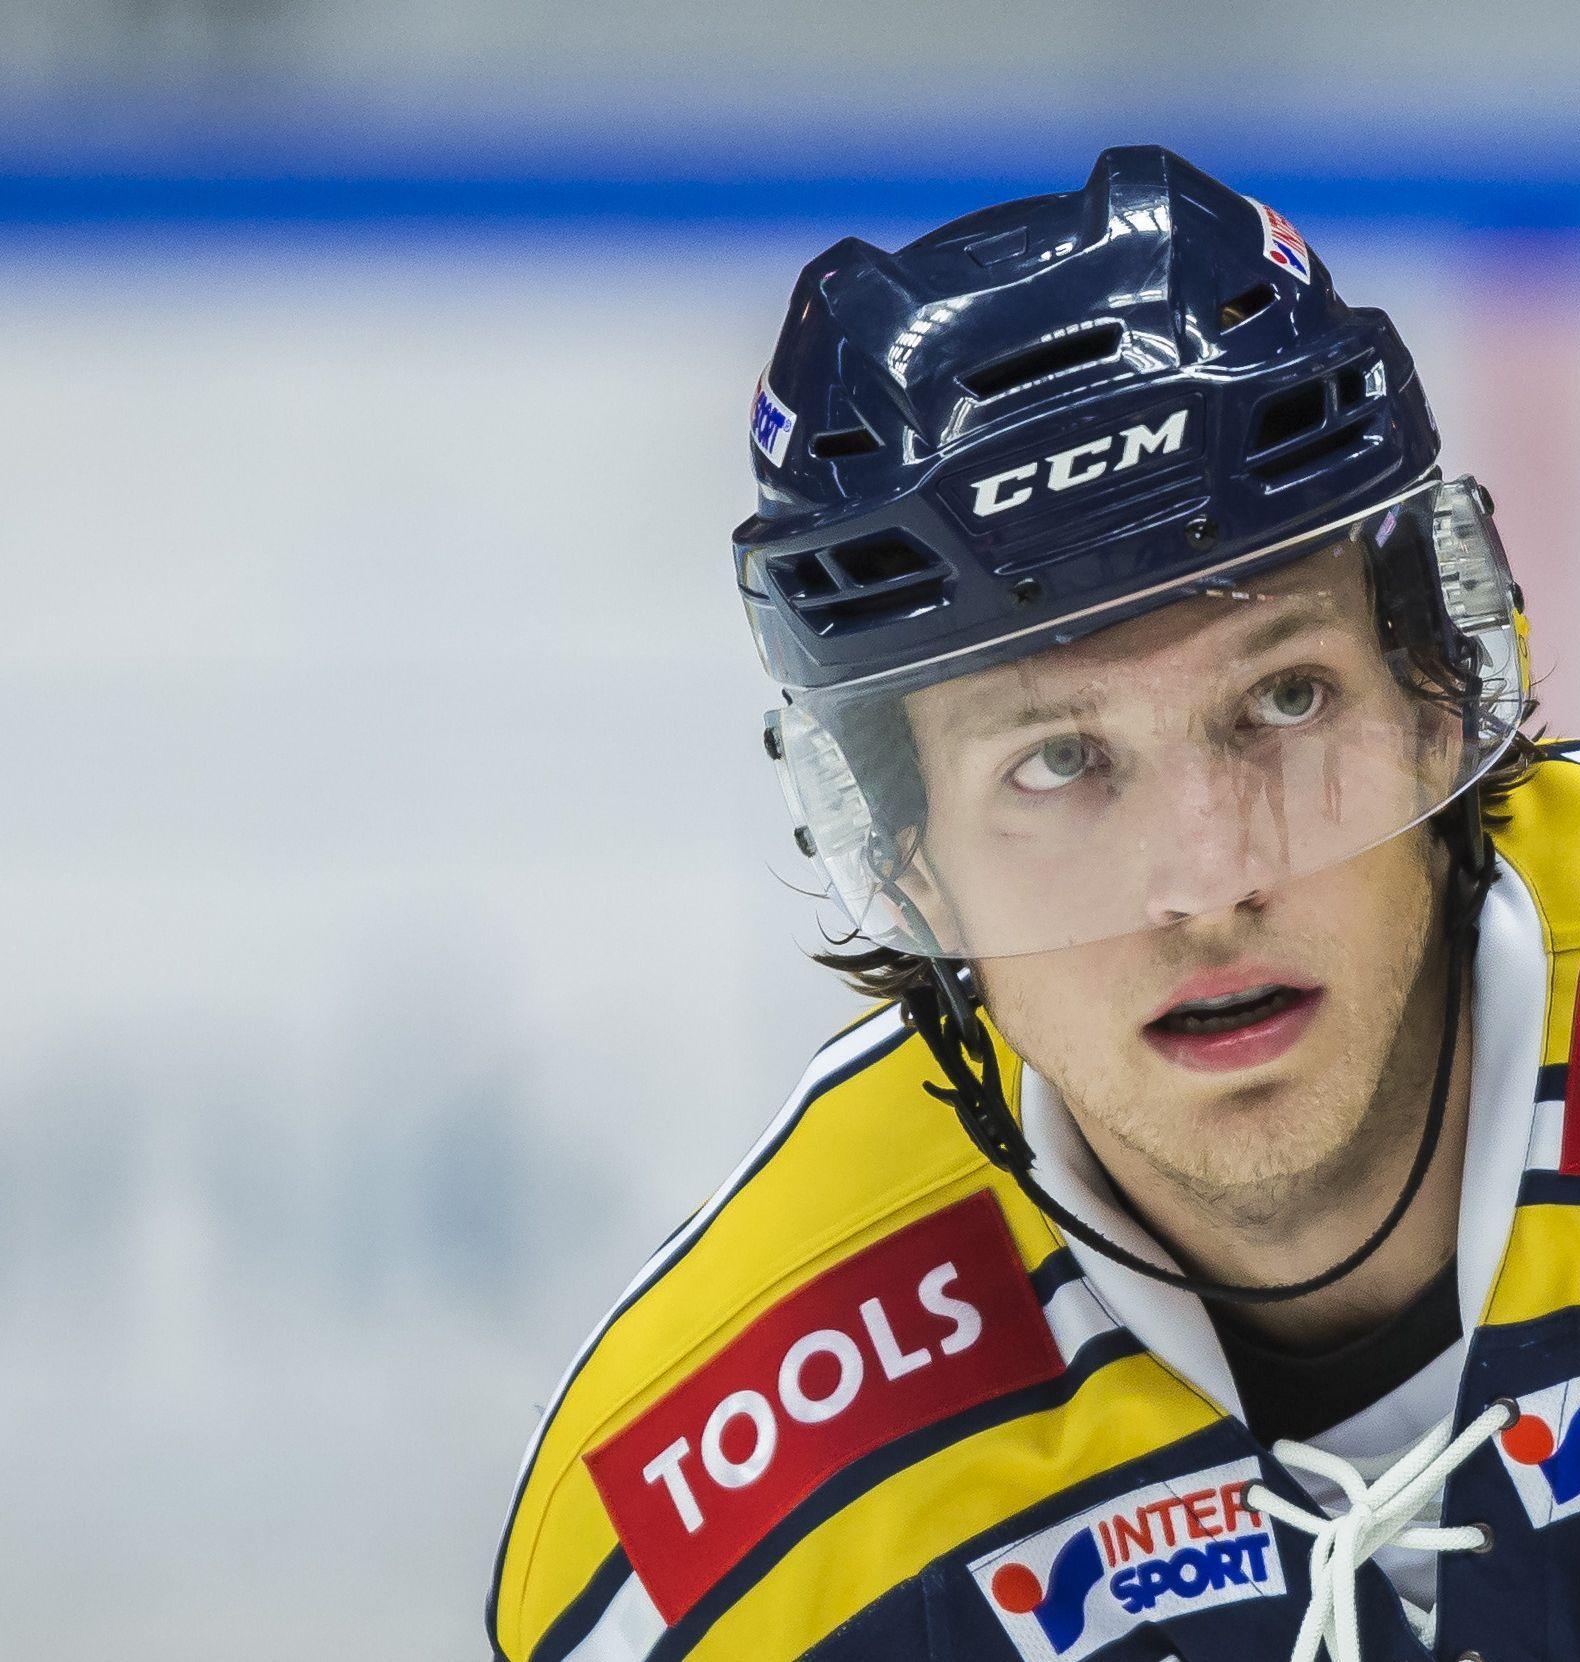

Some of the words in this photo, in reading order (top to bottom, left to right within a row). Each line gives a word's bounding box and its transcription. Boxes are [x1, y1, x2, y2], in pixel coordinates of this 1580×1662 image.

[969, 409, 1189, 517] CCM
[642, 1261, 983, 1534] TOOLS
[1109, 1532, 1271, 1615] SPORT
